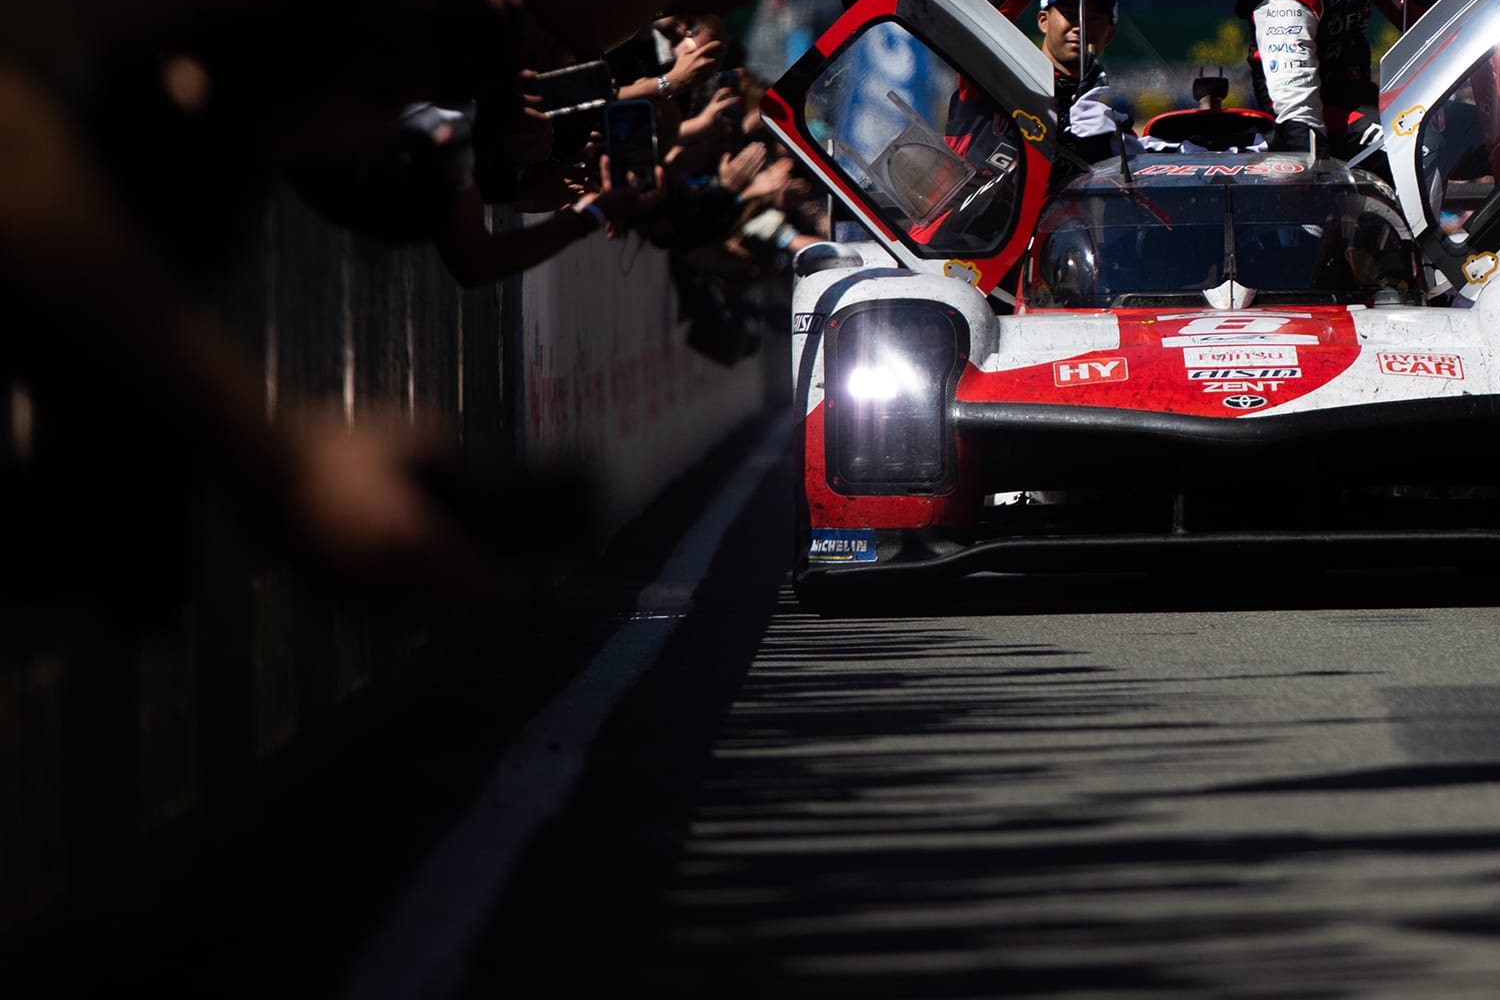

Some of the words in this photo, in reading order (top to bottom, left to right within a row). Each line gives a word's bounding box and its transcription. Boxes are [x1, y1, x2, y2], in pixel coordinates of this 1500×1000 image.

[1266, 9, 1303, 18] Acronis
[1266, 26, 1304, 36] RAYS
[1133, 154, 1305, 176] DENSO
[1178, 317, 1291, 335] 8
[1383, 354, 1455, 364] HYPER
[1059, 361, 1120, 382] HY
[1192, 369, 1298, 379] AISIN
[1386, 360, 1456, 377] CAR
[1202, 381, 1285, 393] ZENT
[810, 539, 868, 553] MICHELIN
